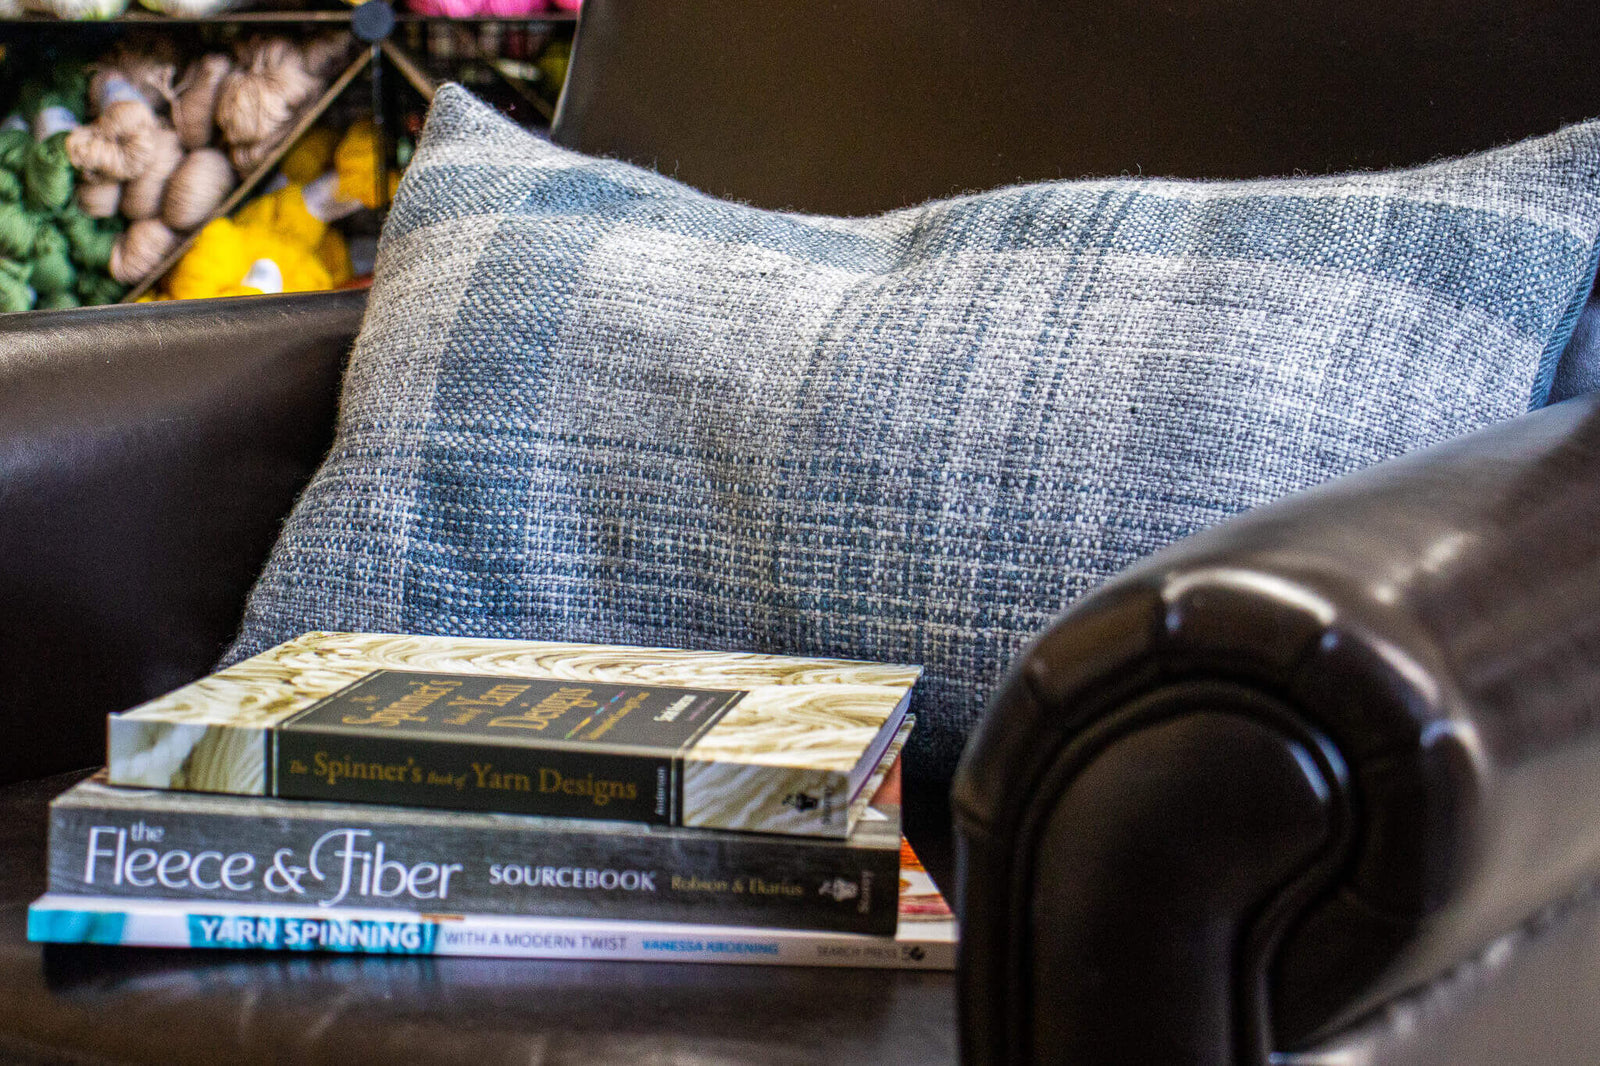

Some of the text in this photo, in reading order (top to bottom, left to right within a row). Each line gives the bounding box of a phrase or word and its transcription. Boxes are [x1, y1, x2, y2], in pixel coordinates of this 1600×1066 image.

[447, 683, 532, 707] Yarn
[313, 751, 422, 786] Spinner's
[471, 762, 531, 791] Yarn
[539, 768, 638, 807] Designs
[132, 820, 164, 843] the
[85, 826, 254, 892] Fleece
[264, 848, 307, 895] &
[309, 828, 463, 908] Fiber
[489, 864, 657, 893] SOURCEBOOK
[671, 875, 728, 893] Robson
[731, 878, 745, 894] &
[199, 918, 276, 944] YARN
[284, 920, 422, 950] SPINNING
[444, 931, 485, 946] WITH
[489, 932, 501, 946] A
[503, 933, 576, 949] MODERN
[581, 935, 627, 952] TWIST
[641, 938, 703, 952] VANESSA
